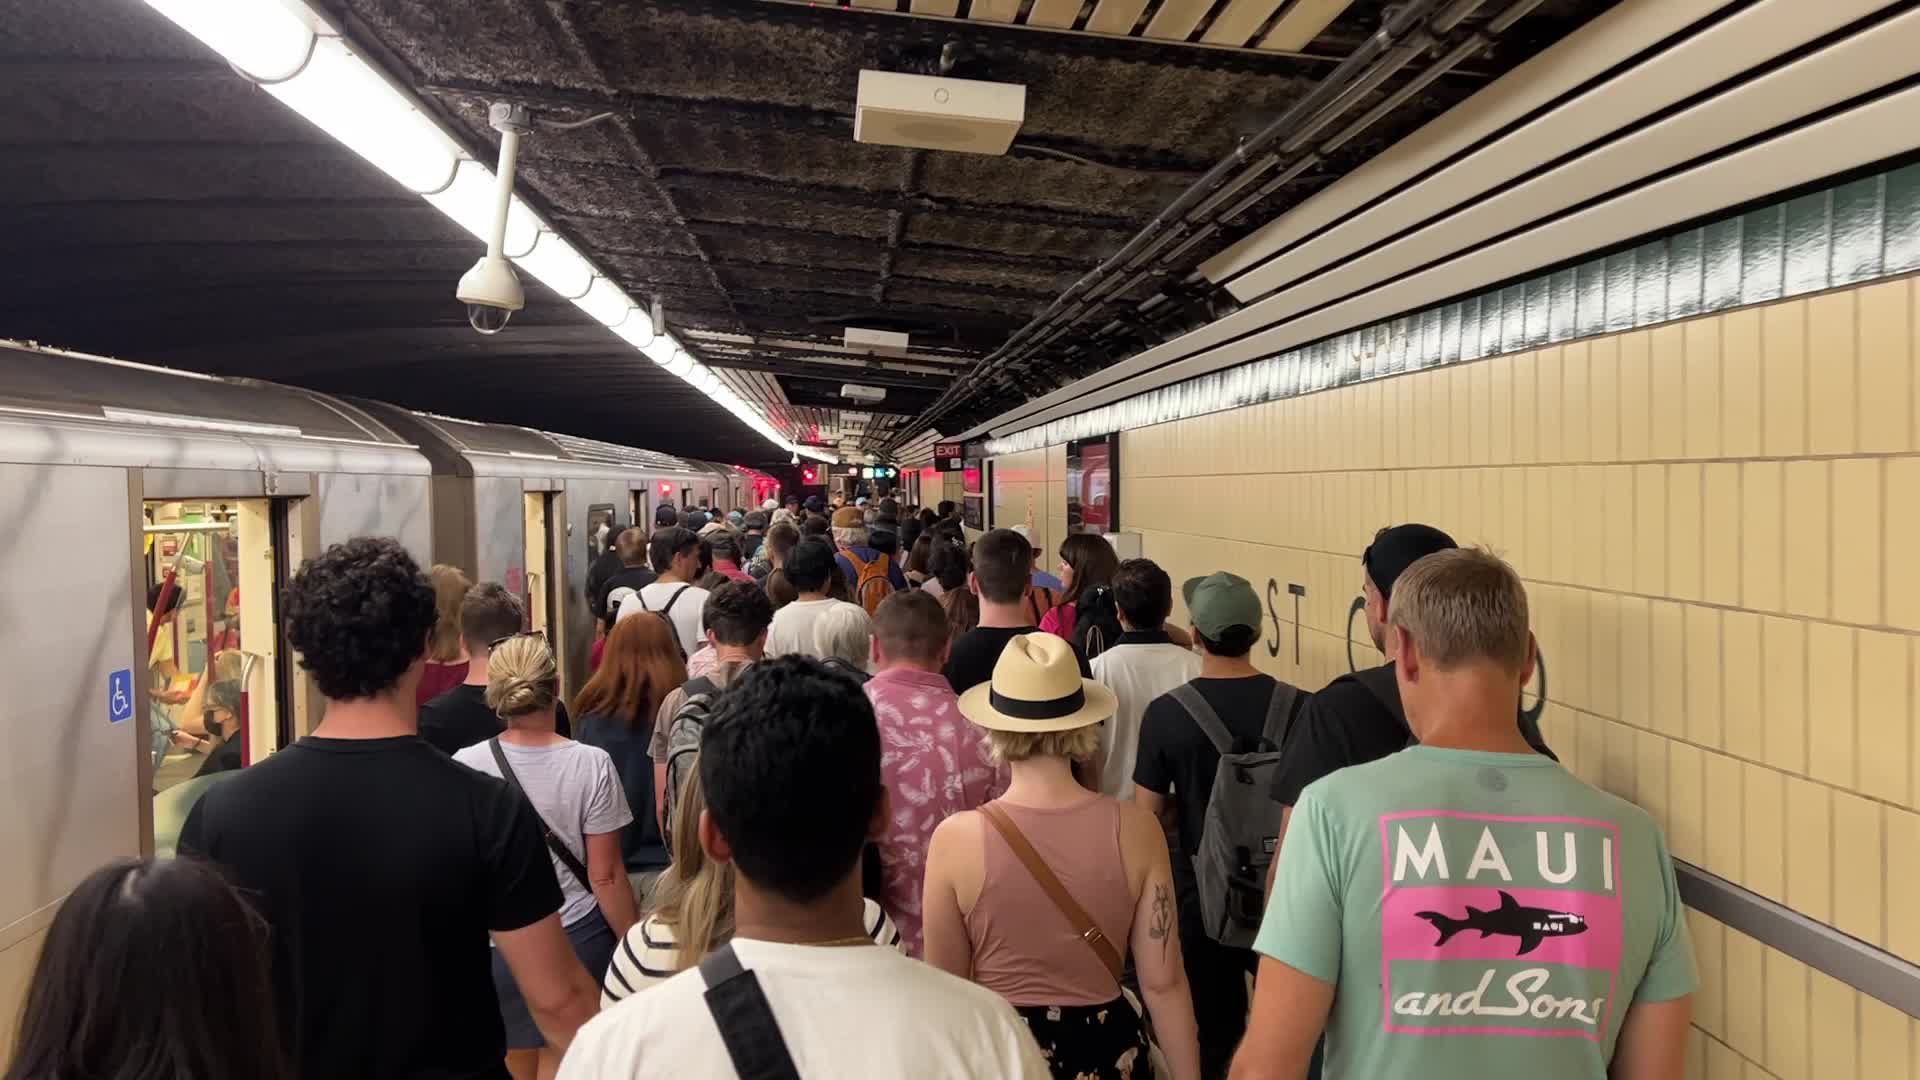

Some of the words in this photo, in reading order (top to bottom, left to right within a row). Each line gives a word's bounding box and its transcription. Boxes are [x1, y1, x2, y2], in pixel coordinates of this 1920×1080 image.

[936, 445, 961, 457] EXIT
[1393, 821, 1614, 891] MAUI
[1394, 968, 1497, 1017] and
